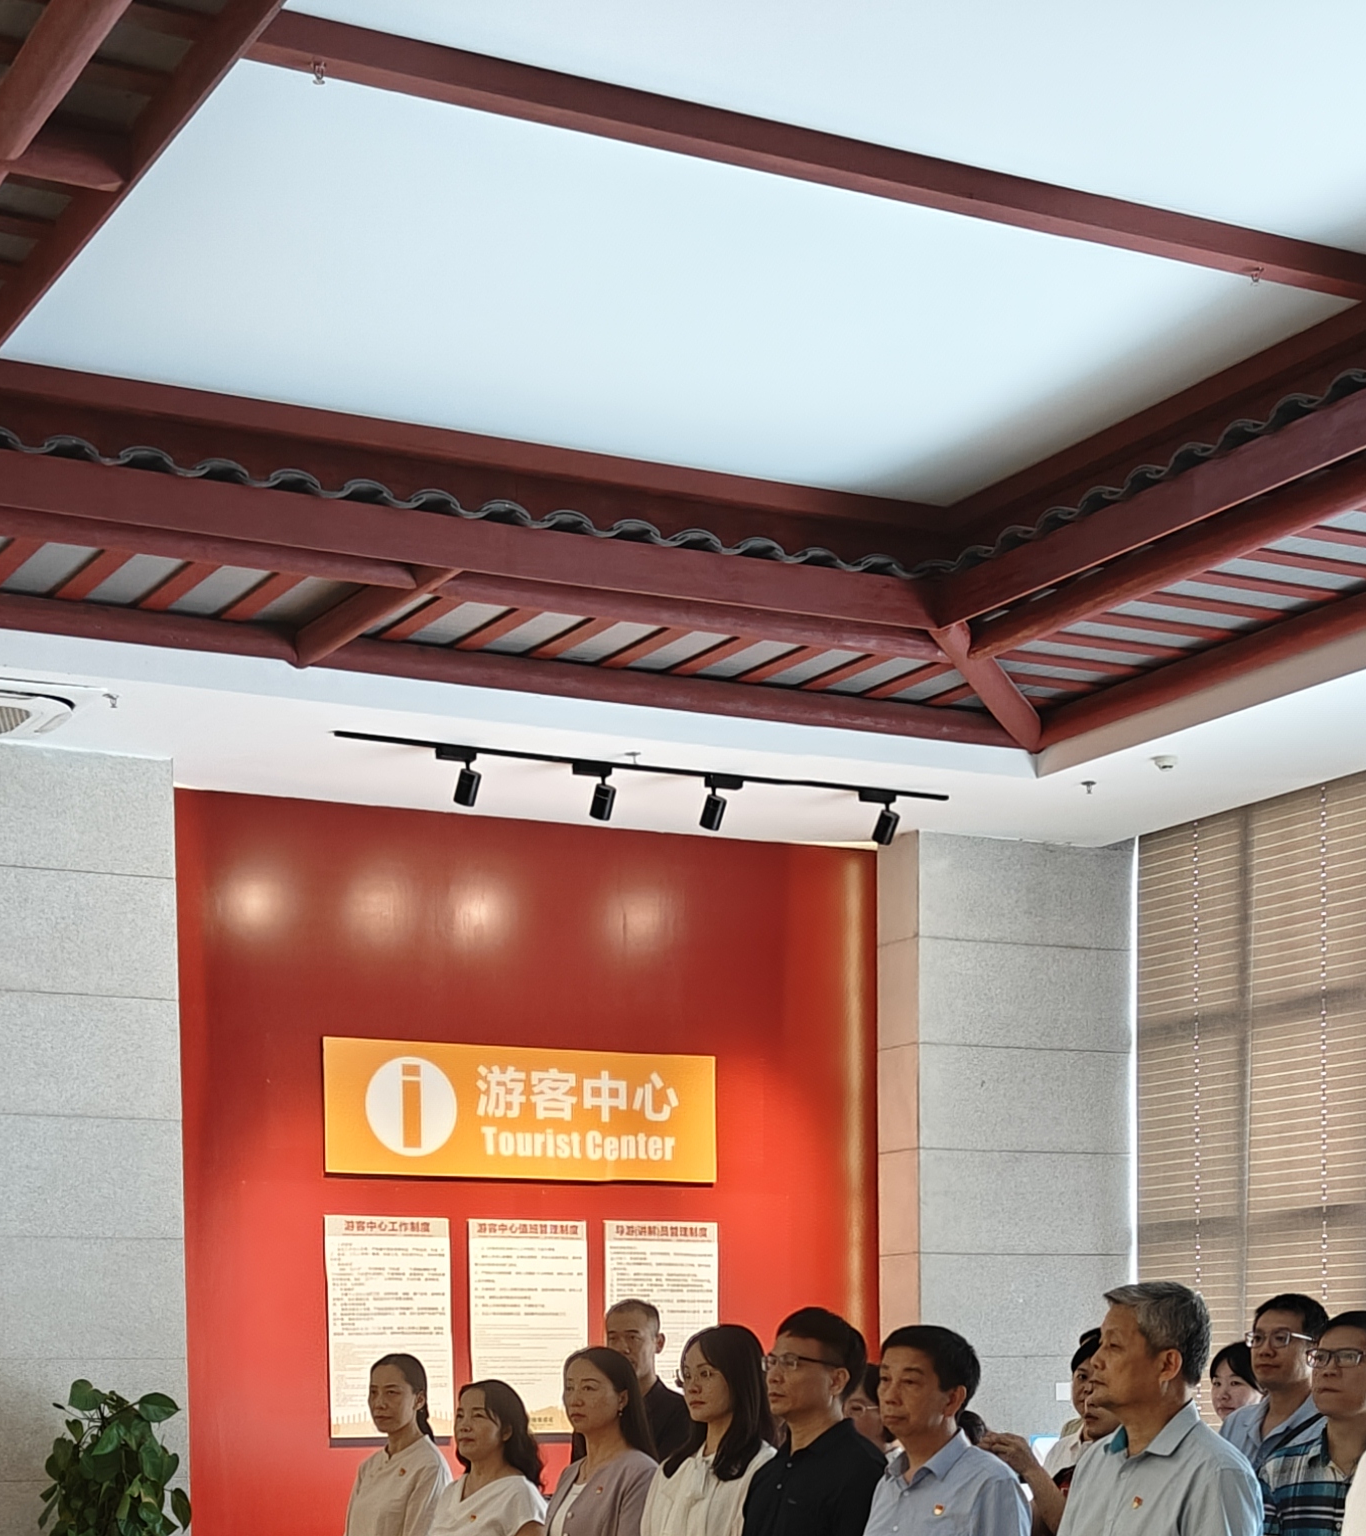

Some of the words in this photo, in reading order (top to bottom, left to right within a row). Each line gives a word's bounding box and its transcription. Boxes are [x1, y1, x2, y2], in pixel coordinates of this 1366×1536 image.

[476, 1064, 679, 1123] 游客中心
[481, 1126, 581, 1159] Tourist
[585, 1130, 676, 1162] Center
[344, 1220, 431, 1233] 游客中心工作制度
[477, 1222, 579, 1235] 游客中心值班管理制度
